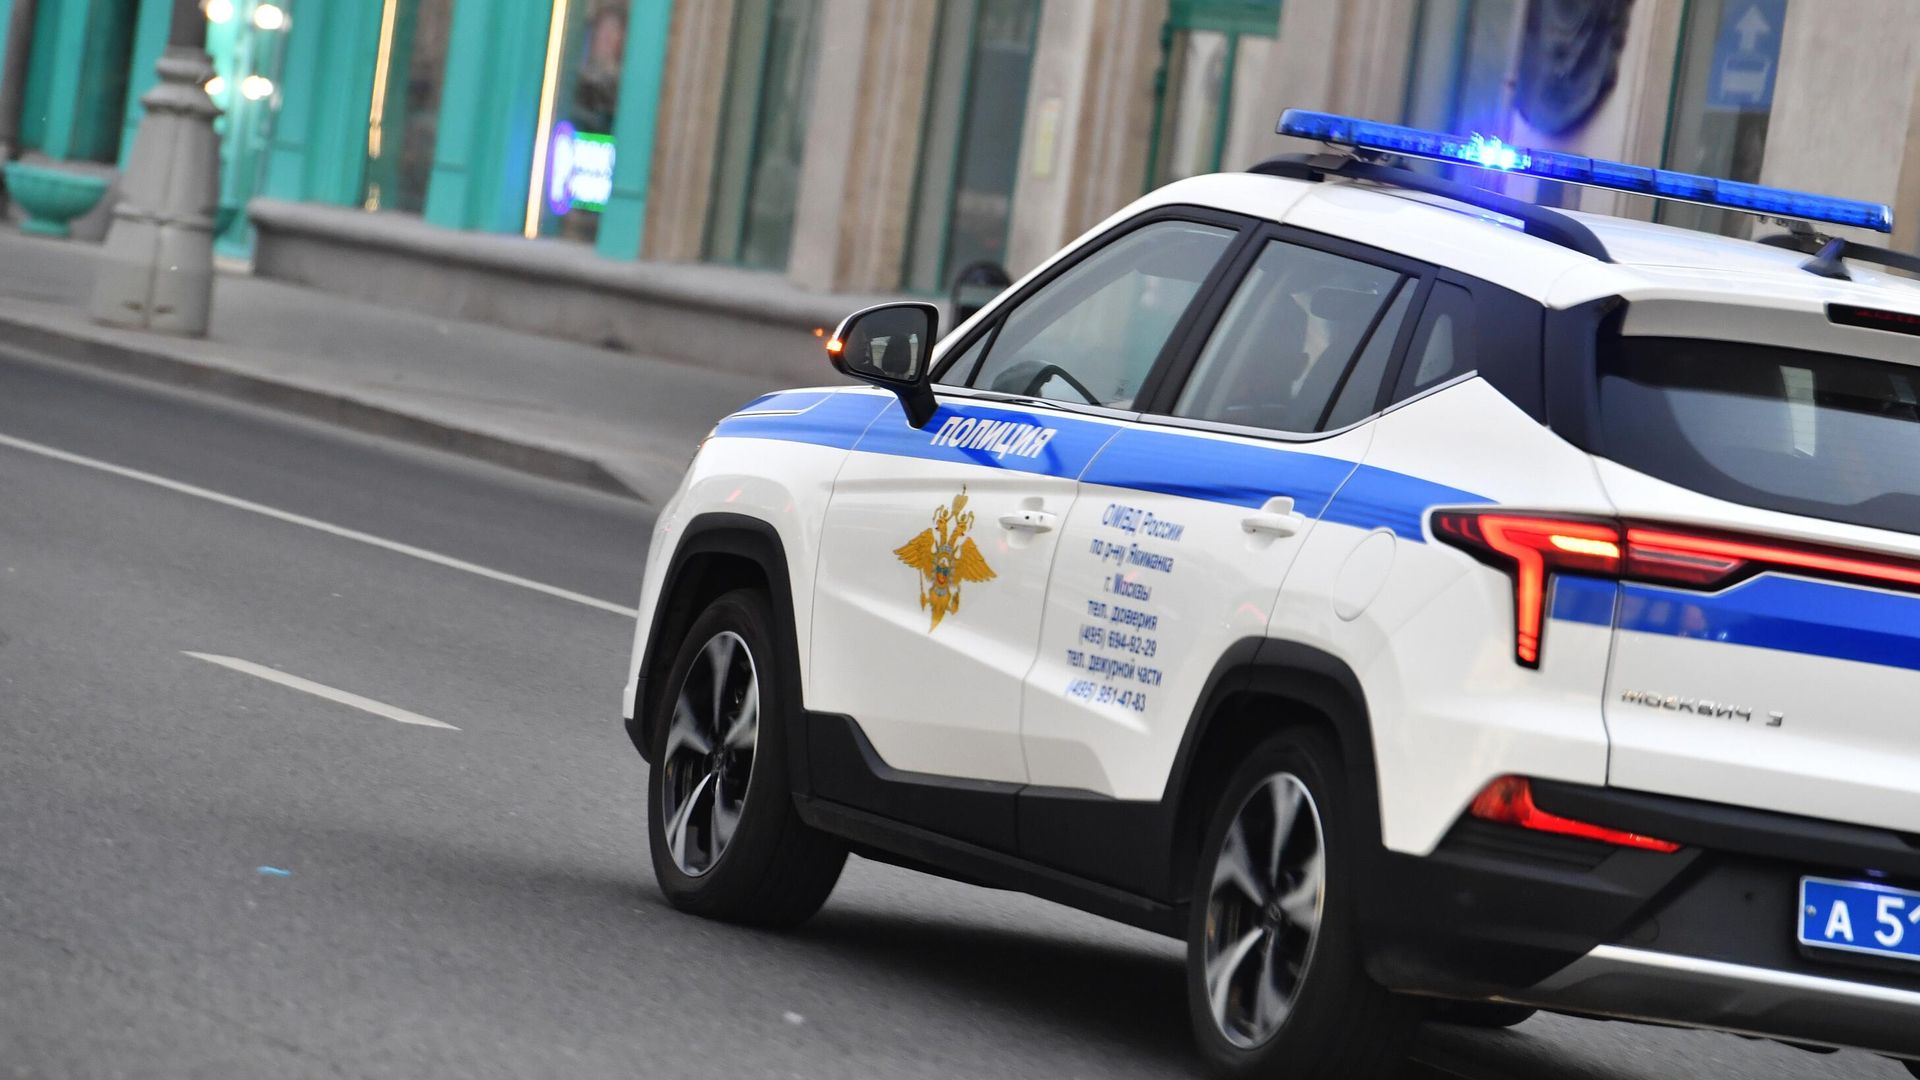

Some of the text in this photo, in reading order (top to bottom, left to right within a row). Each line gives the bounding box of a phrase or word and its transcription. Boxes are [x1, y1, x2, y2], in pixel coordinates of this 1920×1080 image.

[930, 416, 1058, 460] ПОЛИЦИЯ
[1139, 511, 1185, 543] России
[1089, 539, 1104, 556] по
[1126, 543, 1174, 573] Якиманка
[1112, 574, 1152, 601] Москвы
[1088, 600, 1158, 632] тел. доверия
[1079, 624, 1157, 657] (495) 694-92-29
[1066, 650, 1163, 687] тел. дежурной части
[1065, 677, 1097, 702] (495)
[1766, 711, 1783, 728] 3
